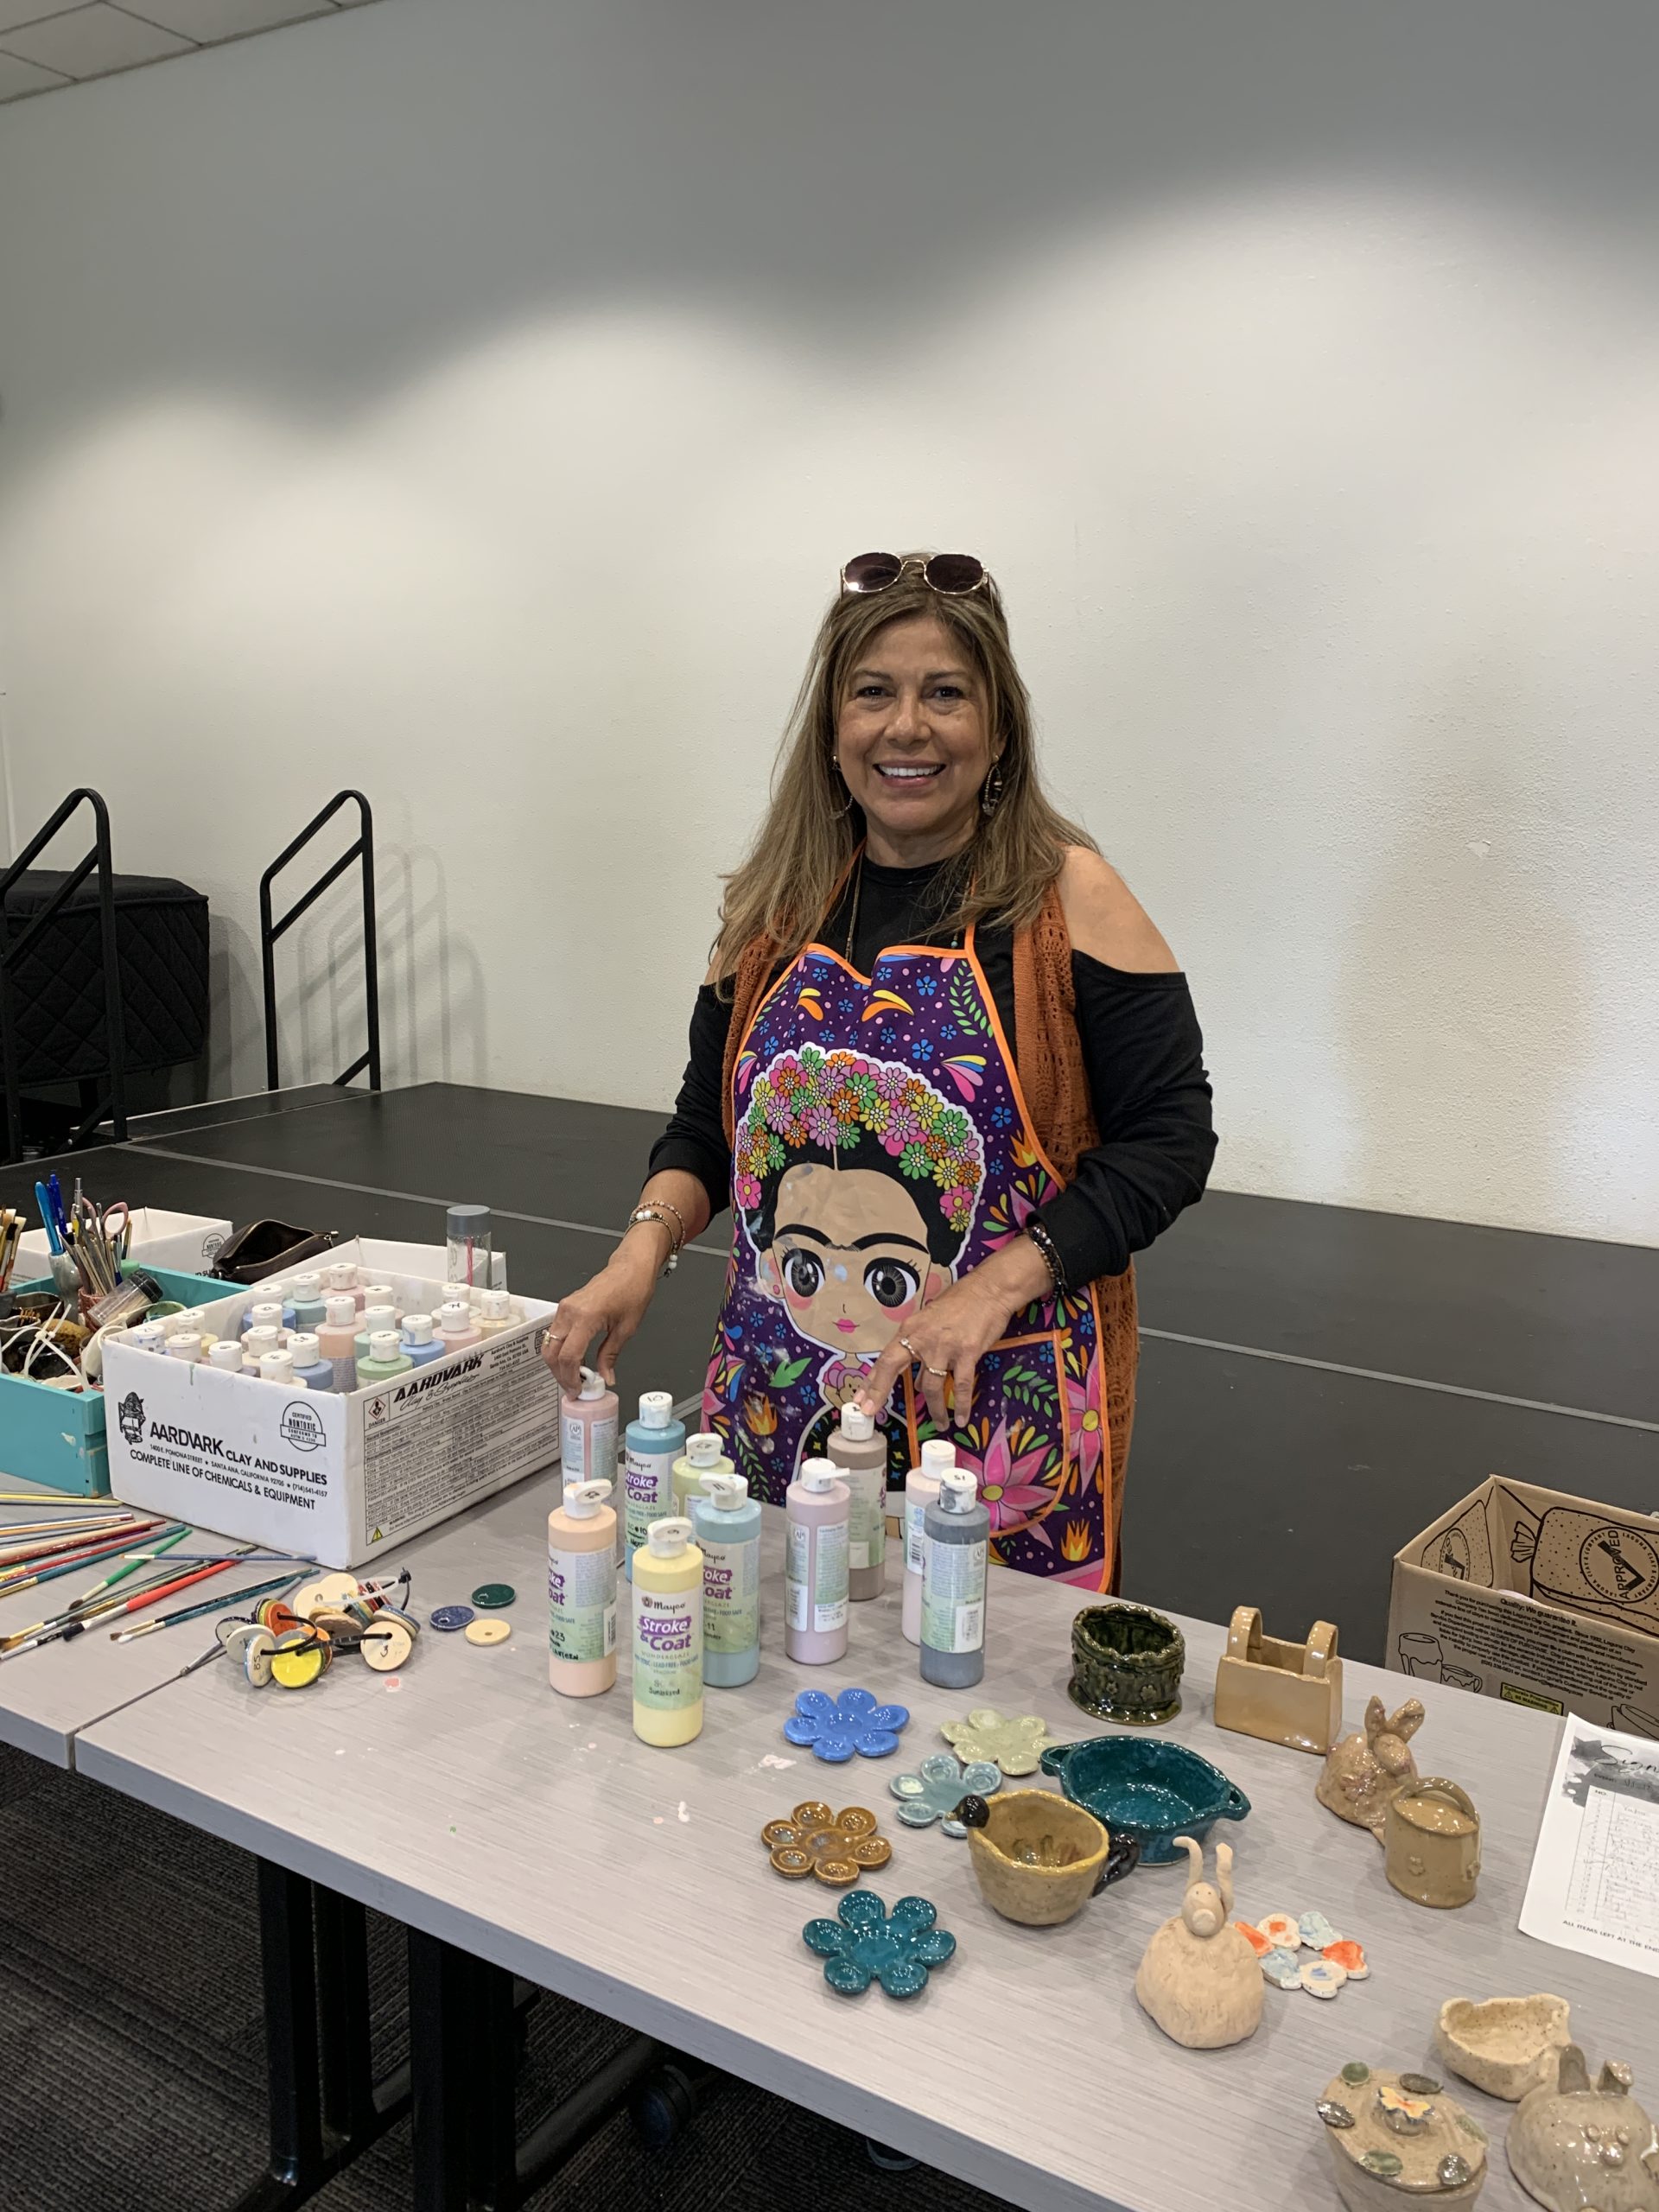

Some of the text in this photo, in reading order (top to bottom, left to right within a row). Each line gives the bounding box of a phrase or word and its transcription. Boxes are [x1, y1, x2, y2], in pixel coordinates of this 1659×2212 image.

[394, 1352, 484, 1403] AARDVARK
[289, 1418, 316, 1432] NONTOXIC
[149, 1421, 327, 1485] AARDVARK CLAY AND SUPPLIES
[149, 1444, 160, 1452] 1400
[165, 1448, 187, 1459] POMONA
[187, 1452, 203, 1464] STREET
[211, 1460, 226, 1471] SANTA
[227, 1465, 239, 1474] ANA,
[240, 1469, 270, 1483] CALIFORNIA
[270, 1477, 284, 1487] 92705
[130, 1449, 315, 1510] COMPLETE LINE OF CHEMICALS & EQUIPMENT
[627, 1486, 658, 1503] Coat
[1607, 1529, 1631, 1600] APPROVED
[548, 1588, 566, 1606] oat
[704, 1586, 733, 1600] oat
[653, 1600, 686, 1615] Mayco
[1500, 1598, 1525, 1611] Quality:
[1537, 1609, 1571, 1625] guarantee
[642, 1618, 689, 1634] Stroke
[640, 1632, 692, 1651] & Coat
[1562, 1919, 1574, 1928] ALL
[1577, 1923, 1598, 1935] ITEMS
[1599, 1929, 1615, 1940] LEFT
[1629, 1939, 1642, 1948] THE
